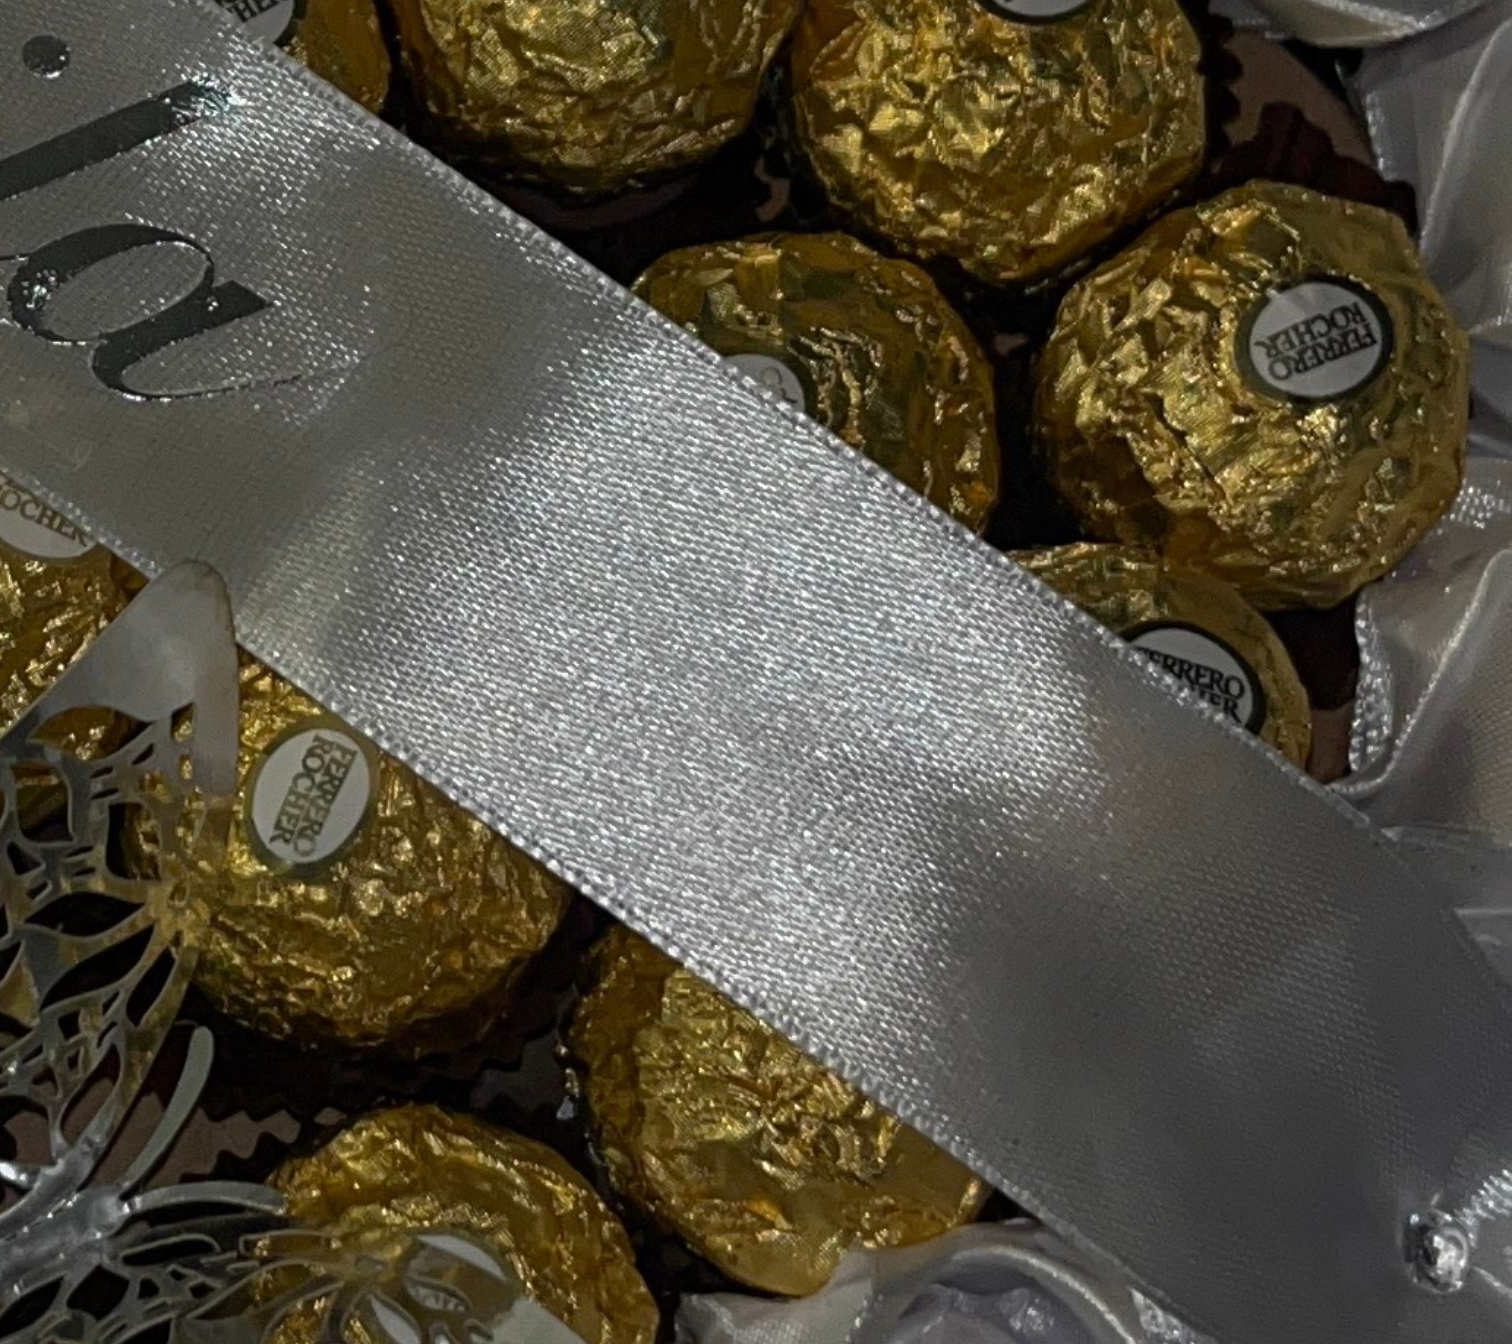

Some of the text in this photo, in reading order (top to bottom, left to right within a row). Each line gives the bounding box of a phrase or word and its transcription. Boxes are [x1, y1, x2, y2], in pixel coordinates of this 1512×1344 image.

[1254, 302, 1367, 358] ROCHER
[1268, 322, 1377, 381] FERRERO
[269, 734, 336, 844] ROCHER
[293, 742, 360, 856] FERRERO
